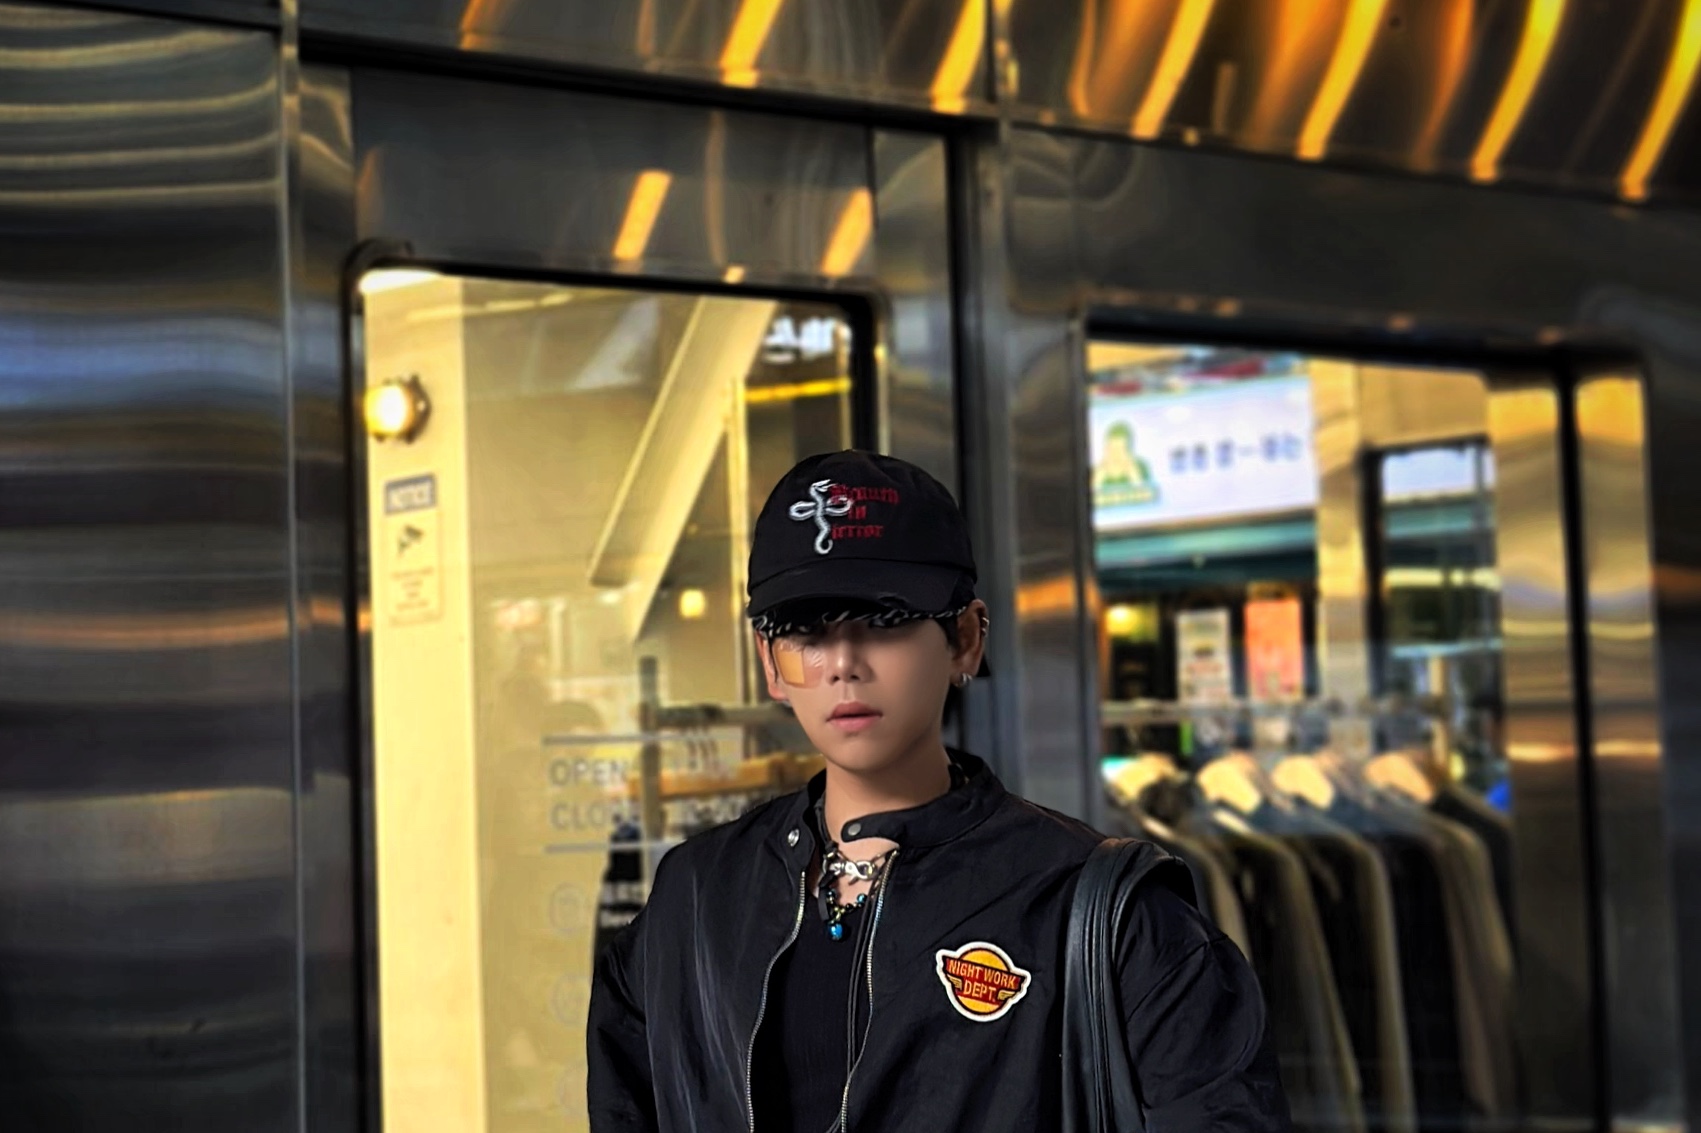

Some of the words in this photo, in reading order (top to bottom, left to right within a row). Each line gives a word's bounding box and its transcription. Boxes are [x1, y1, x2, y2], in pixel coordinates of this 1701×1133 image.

[549, 757, 629, 786] OPEN
[948, 959, 984, 979] NIGHT
[984, 968, 1017, 990] WORK
[963, 979, 997, 1002] DEPT.
